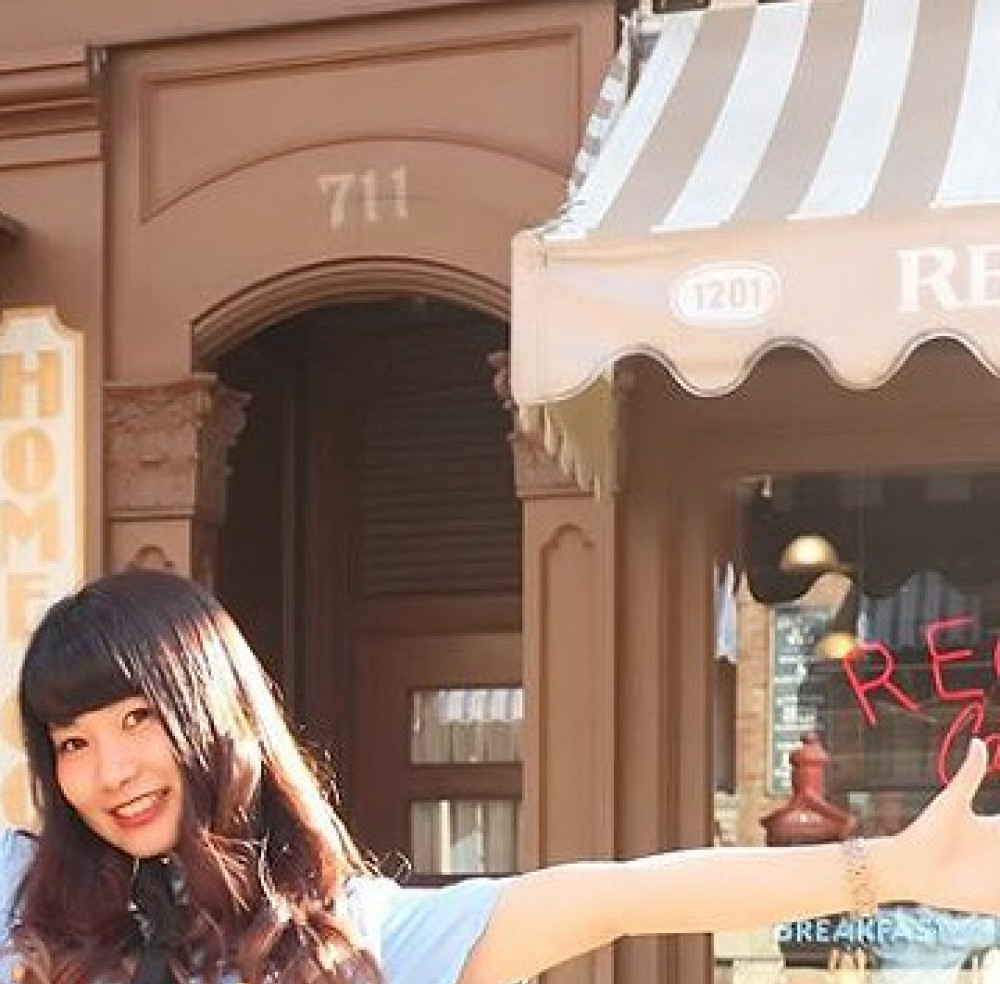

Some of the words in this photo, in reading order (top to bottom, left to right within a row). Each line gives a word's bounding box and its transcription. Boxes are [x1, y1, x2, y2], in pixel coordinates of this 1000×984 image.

[318, 166, 409, 229] 711
[693, 277, 764, 311] 1201
[842, 613, 1000, 727] RE
